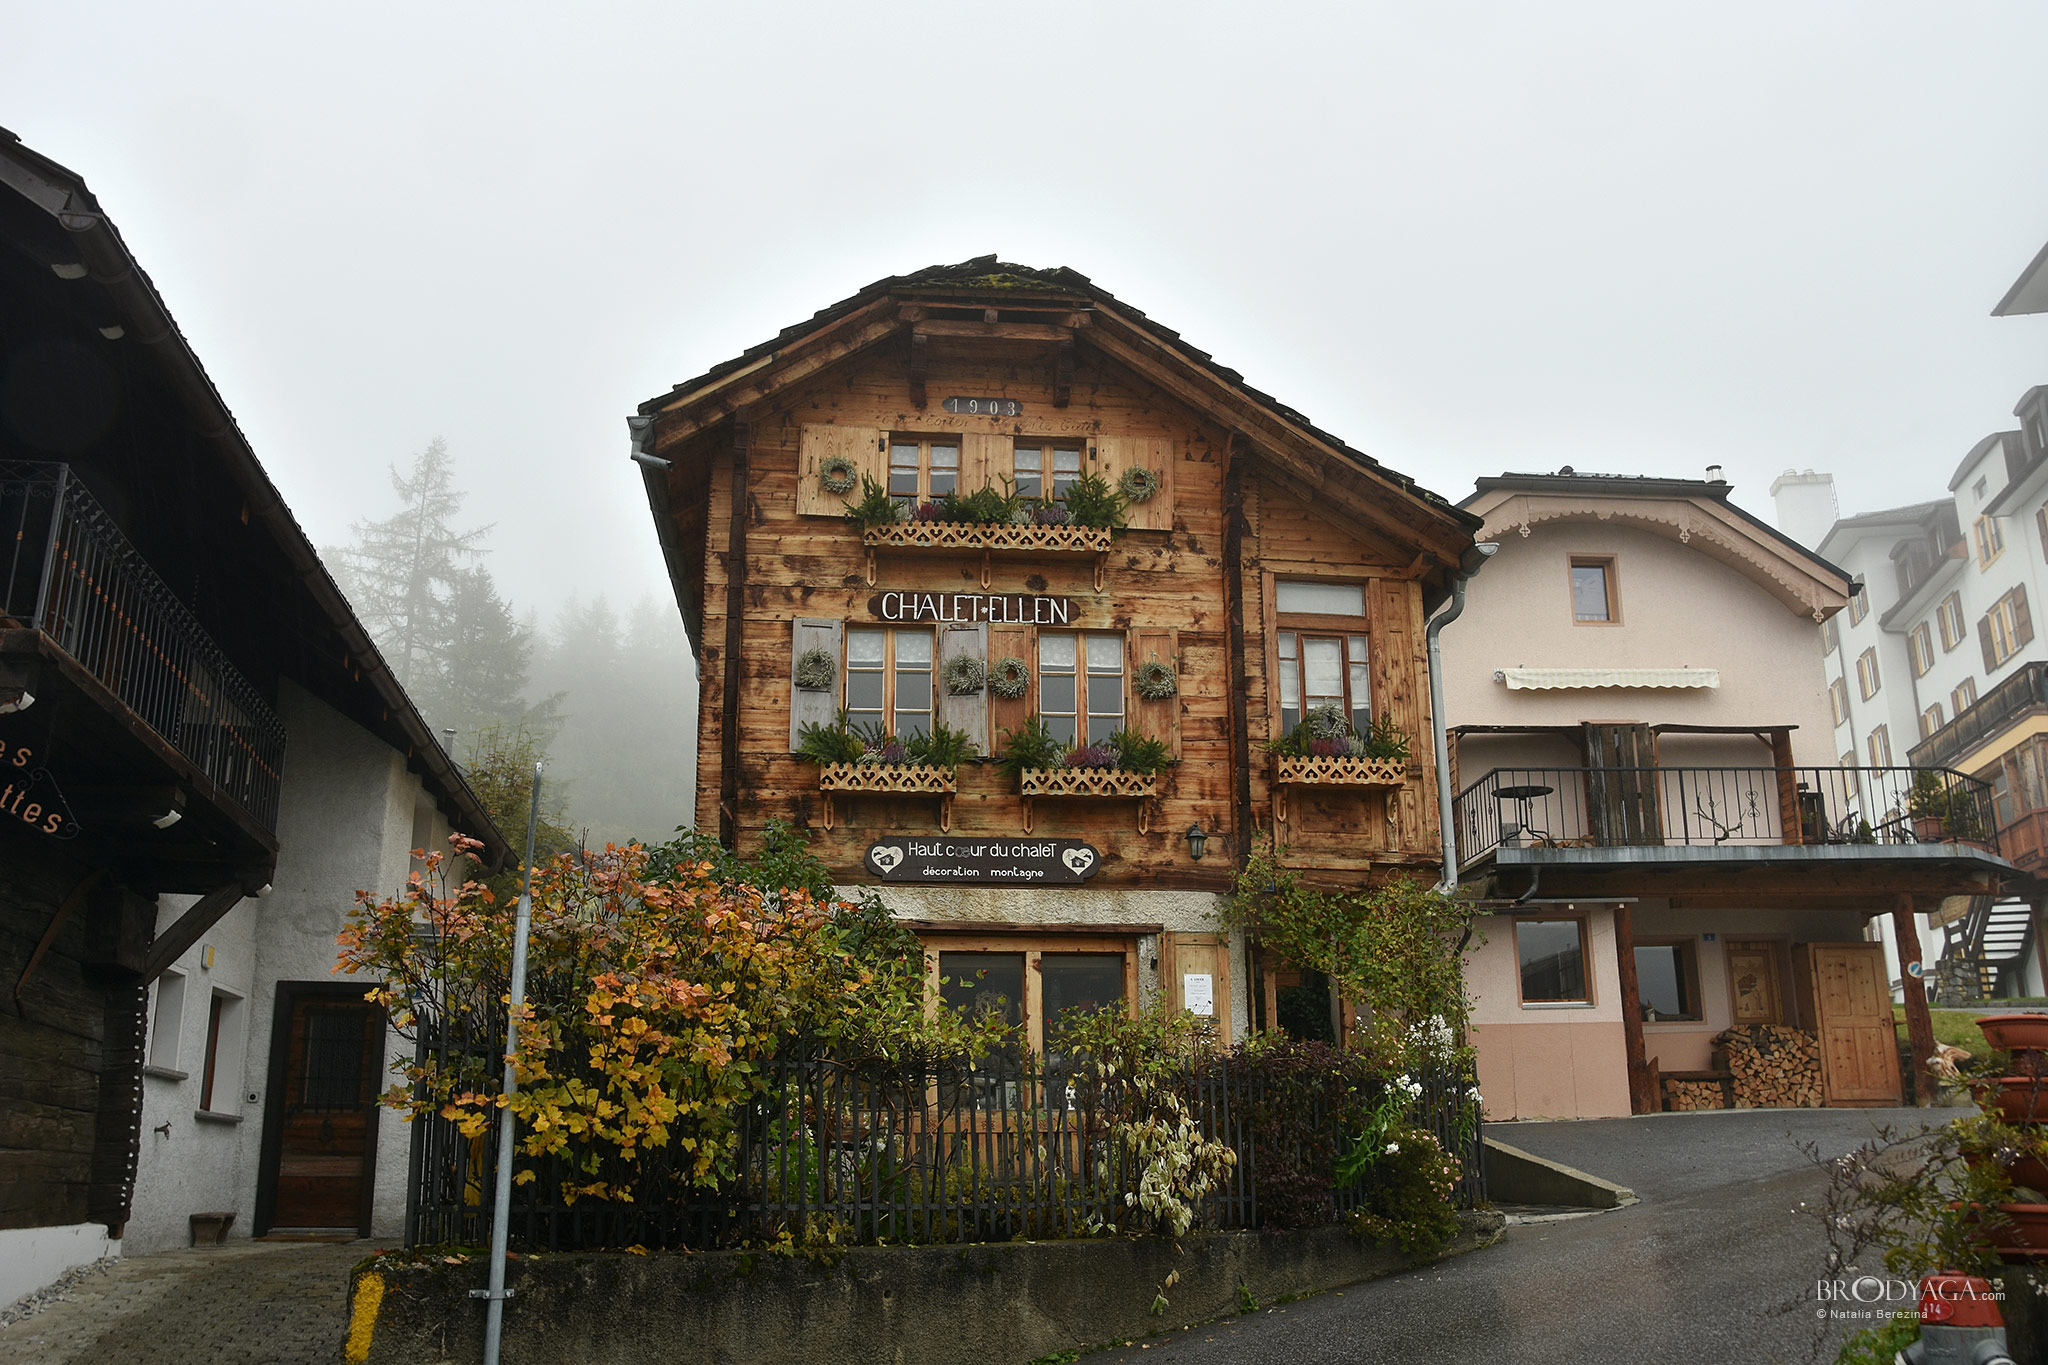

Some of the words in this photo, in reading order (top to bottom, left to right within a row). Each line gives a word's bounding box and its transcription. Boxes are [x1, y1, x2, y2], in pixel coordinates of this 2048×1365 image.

[950, 398, 1016, 416] 1903
[881, 592, 983, 623] CHALET
[988, 595, 1069, 624] ELLEN
[908, 841, 944, 857] Haut
[989, 842, 1009, 858] du
[922, 865, 980, 876] décoration
[990, 865, 1044, 880] montagne
